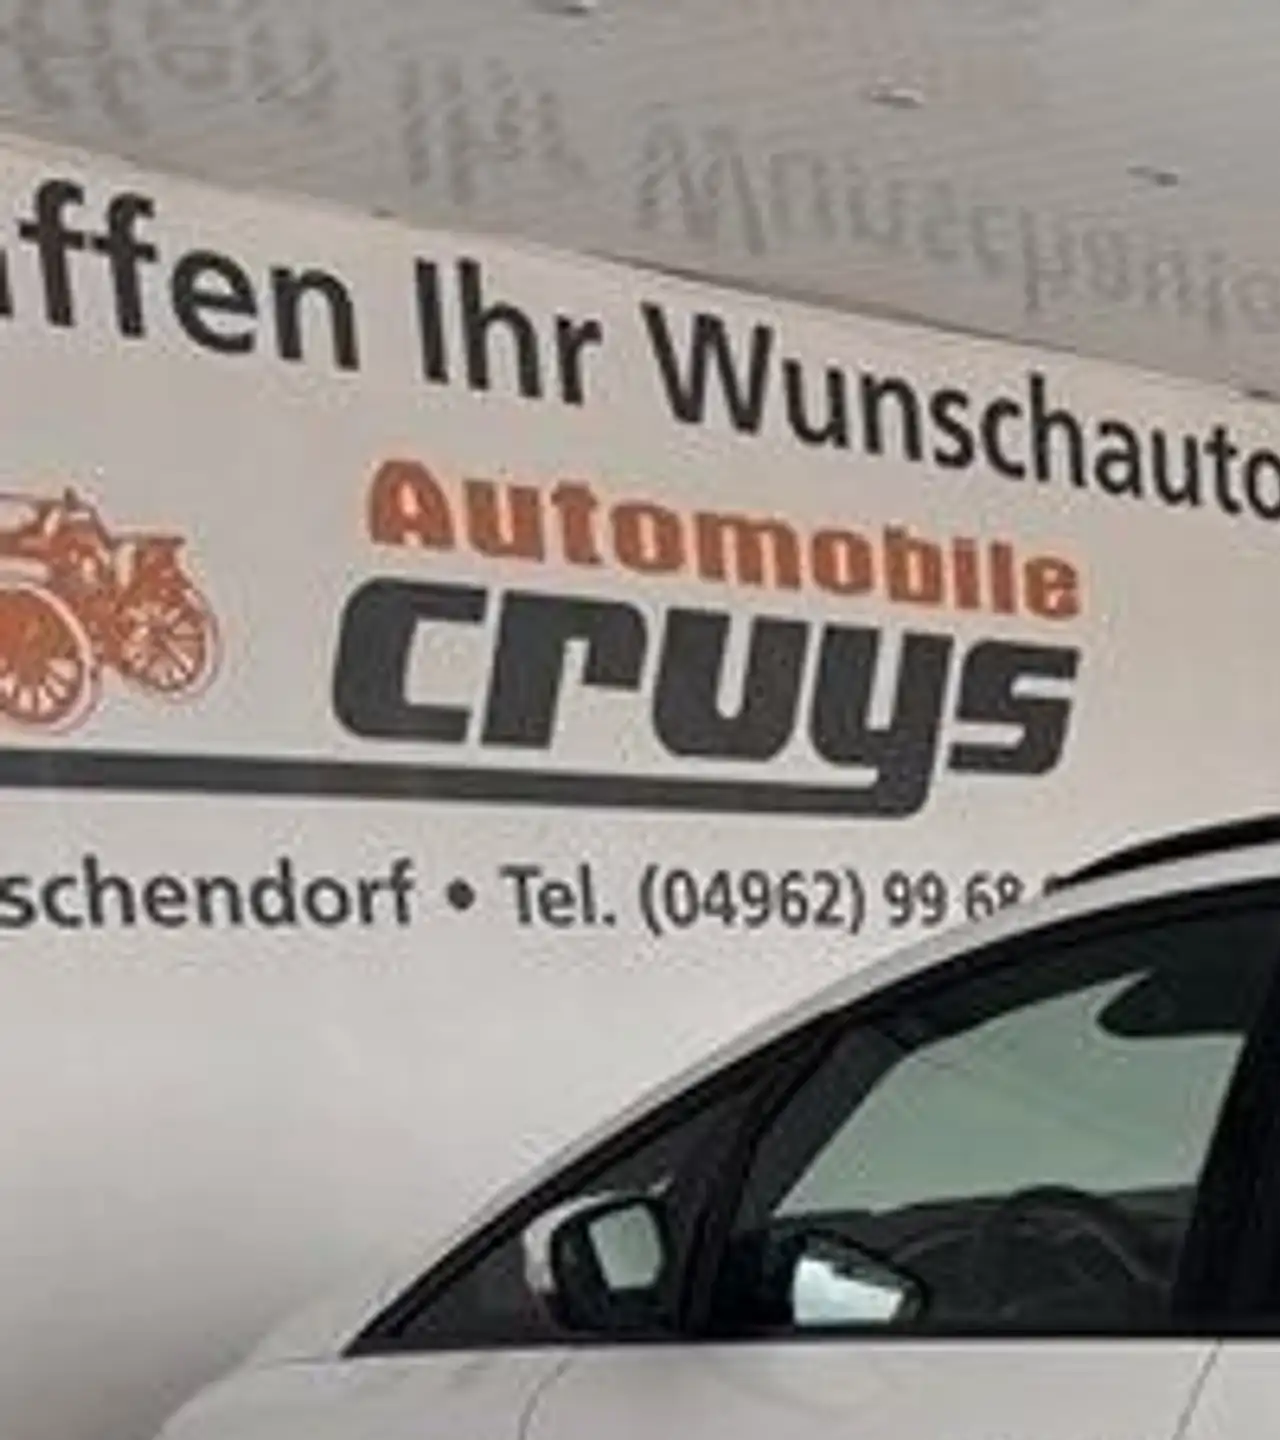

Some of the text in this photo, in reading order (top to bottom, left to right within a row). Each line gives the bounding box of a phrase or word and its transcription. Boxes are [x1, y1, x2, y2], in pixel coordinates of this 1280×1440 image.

[0, 178, 359, 371] ffen
[416, 257, 602, 406] Ihr
[366, 458, 1081, 621] Automobile
[0, 855, 413, 929] schendorf
[501, 864, 616, 926] Tel.
[640, 865, 865, 936] (04962)
[883, 870, 947, 927] 99
